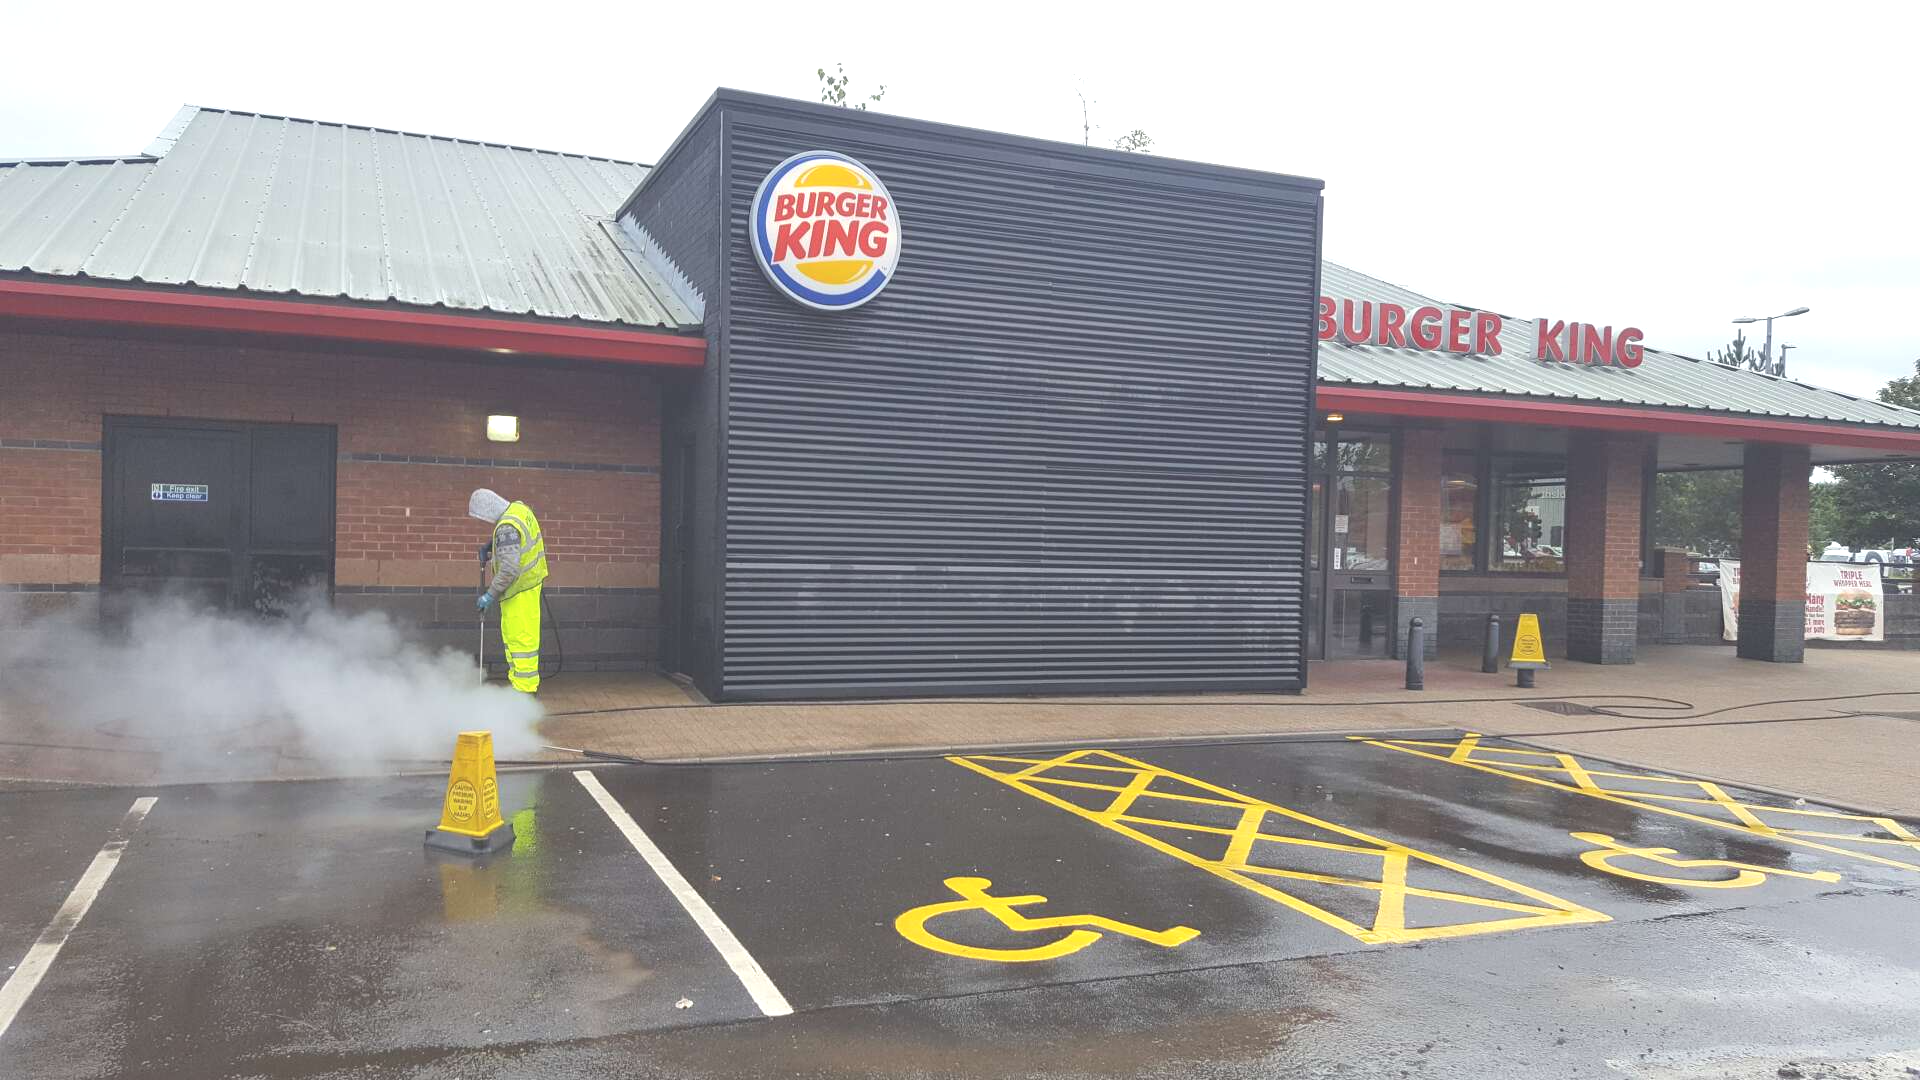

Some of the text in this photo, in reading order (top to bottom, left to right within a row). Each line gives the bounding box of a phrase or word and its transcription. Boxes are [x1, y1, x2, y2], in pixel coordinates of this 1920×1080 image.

[774, 191, 888, 222] BURGER
[773, 219, 889, 262] KING
[1318, 296, 1645, 369] BURGER KING
[1840, 570, 1862, 579] TRIPLE
[1859, 580, 1873, 588] MEAL
